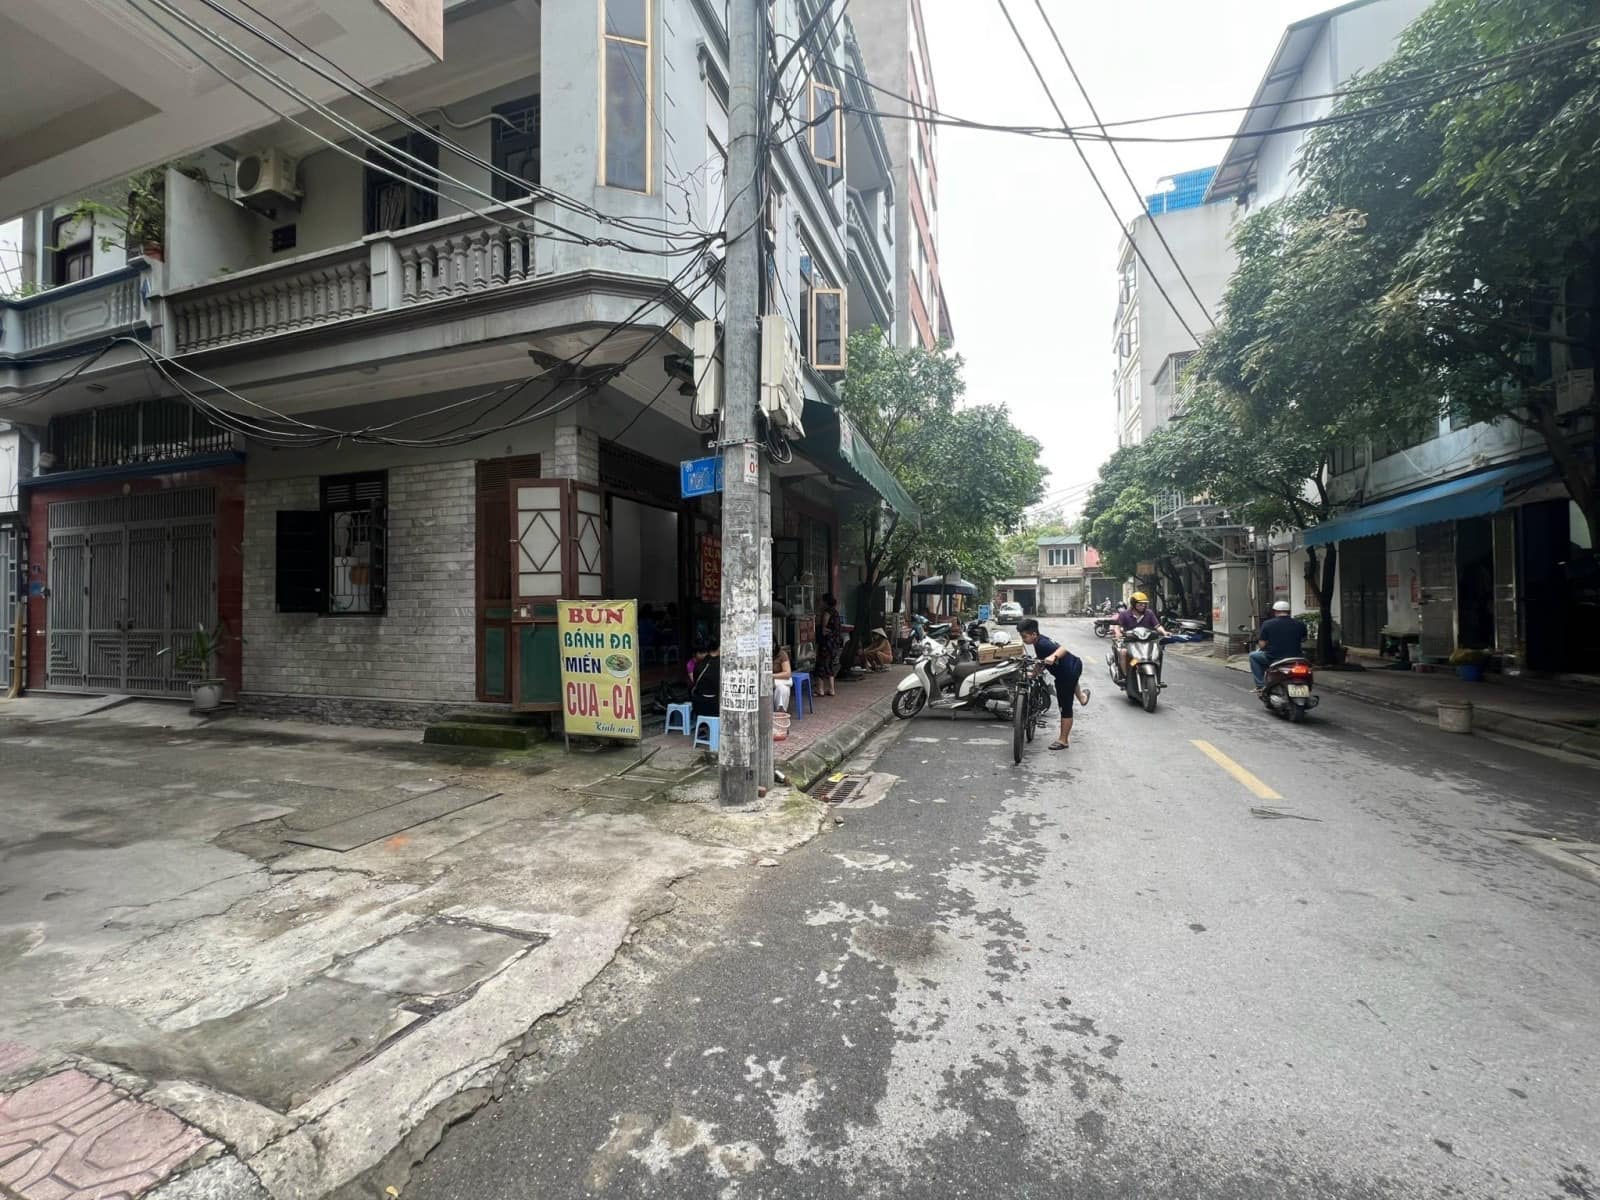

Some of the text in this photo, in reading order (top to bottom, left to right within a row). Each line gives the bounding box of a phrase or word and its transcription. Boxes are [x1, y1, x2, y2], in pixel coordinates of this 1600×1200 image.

[567, 604, 625, 625] BÚN
[564, 628, 632, 650] BÁNH ĐA
